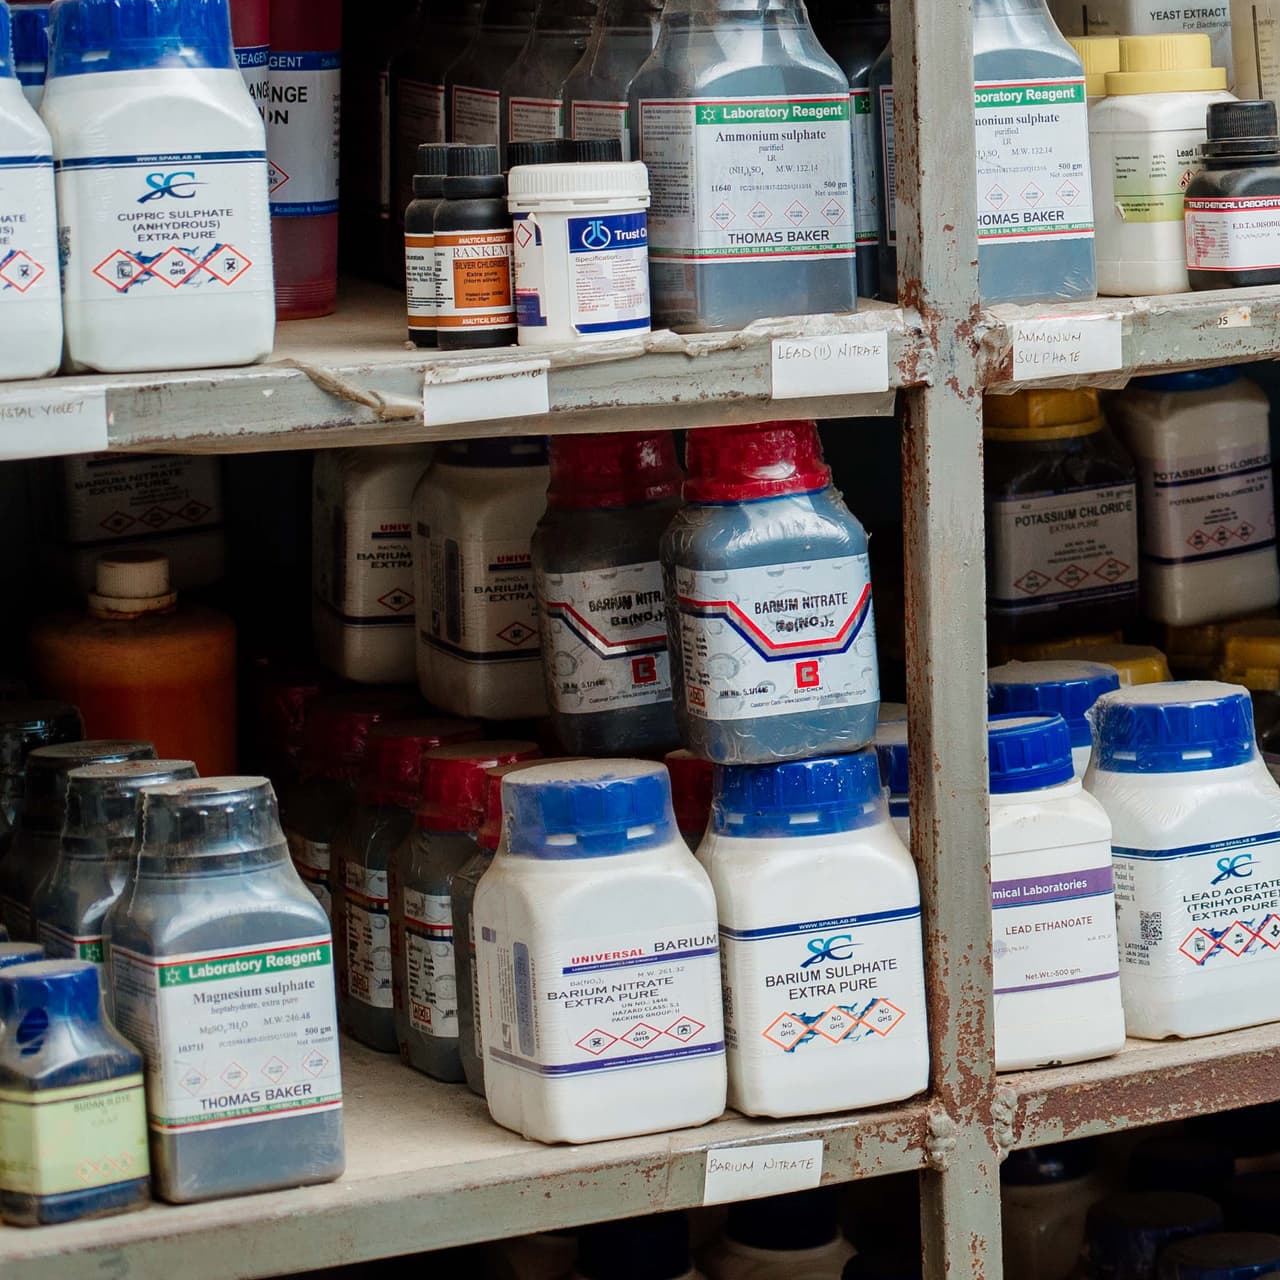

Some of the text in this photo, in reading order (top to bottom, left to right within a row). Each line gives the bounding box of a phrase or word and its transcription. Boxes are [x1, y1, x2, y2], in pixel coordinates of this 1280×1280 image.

[1150, 7, 1227, 21] YEAST EXTRACT
[722, 104, 843, 122] Laboratory Reagent
[715, 128, 827, 143] Ammonium sulphate
[118, 209, 233, 221] CUPRIC SULPHATE
[1023, 209, 1065, 224] BAKER
[133, 219, 221, 232] (ANHYDROUS)
[137, 230, 216, 242] EXTRA PURE
[614, 229, 638, 241] Trust
[728, 229, 830, 245] THOMAS BAKER
[453, 247, 508, 259] RANKEM
[1016, 330, 1081, 344] AMMONIUM
[1015, 352, 1080, 365] SULPHATE
[1014, 499, 1133, 527] POTASSIUM CHLORIDE
[754, 592, 847, 614] BARIUM NITRATE
[1022, 878, 1088, 897] Laboratories
[1182, 890, 1221, 904] LEAD
[1191, 899, 1279, 922] EXTRA PURE
[1005, 916, 1093, 935] LEAD ETHANOATE
[571, 933, 717, 965] UNIVERSAL BARIUM
[188, 949, 322, 979] Laboratory Reagent
[765, 958, 898, 988] BARIUM SULPHATE
[193, 978, 316, 1006] Magnesium sulphate
[547, 976, 674, 1001] BARIUM NITRATE
[788, 976, 878, 1001] EXTRA PURE
[564, 989, 659, 1009] EXTRA PURE
[200, 1083, 312, 1111] THOMAS BAKER
[709, 1157, 814, 1174] BARIUM NITRATE
